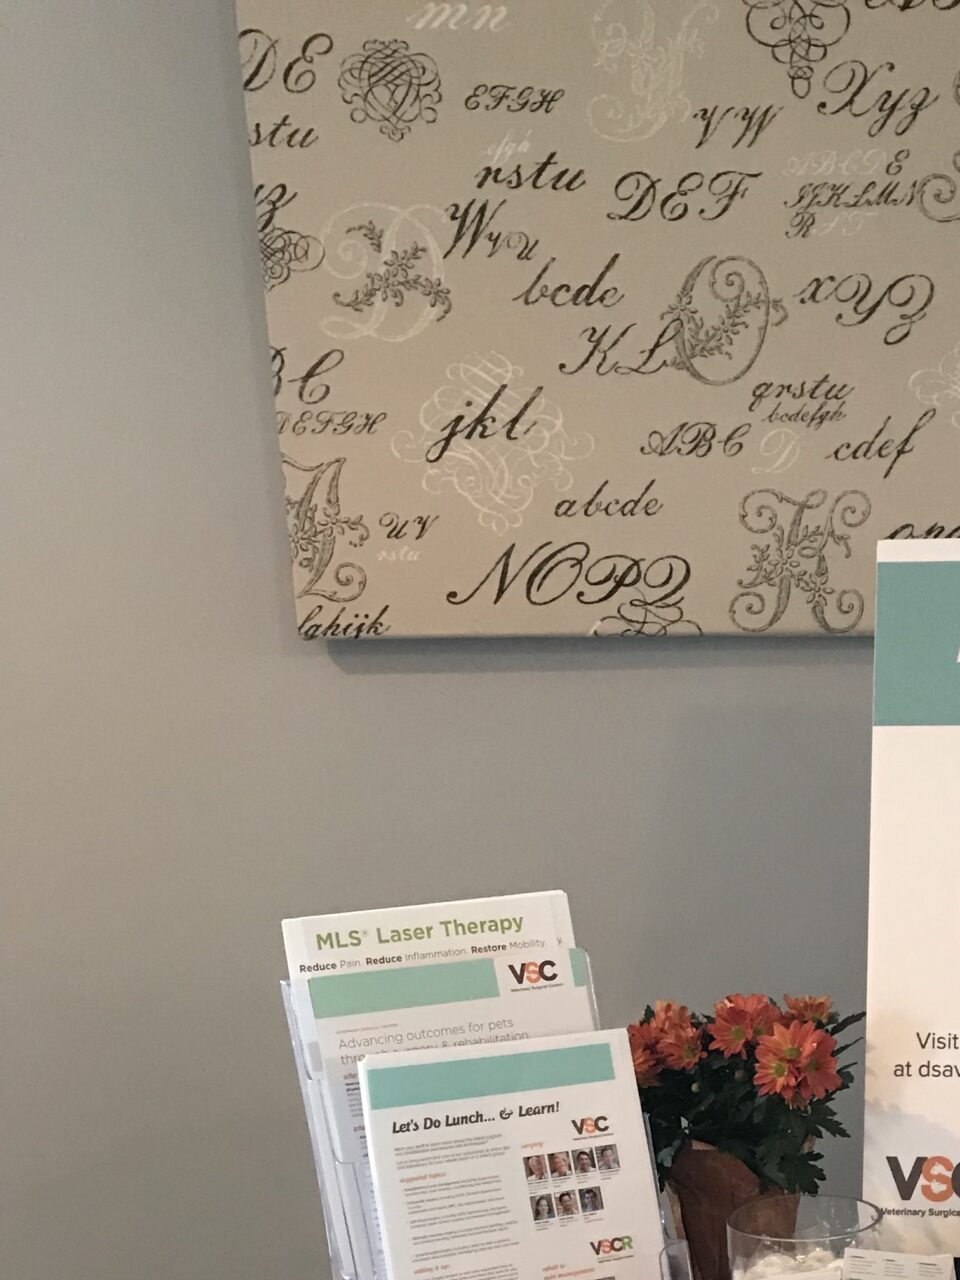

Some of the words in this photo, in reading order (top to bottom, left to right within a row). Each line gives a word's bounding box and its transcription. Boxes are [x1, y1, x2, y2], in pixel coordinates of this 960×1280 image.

[513, 253, 624, 308] bcde
[425, 384, 543, 463] jkl
[553, 478, 663, 518] abcde
[376, 923, 433, 945] Laser
[439, 915, 524, 941] Therapy
[299, 961, 337, 974] Reduce
[365, 954, 403, 966] Reduce
[471, 943, 507, 955] Restore
[508, 960, 558, 984] VSC
[338, 1032, 404, 1051] Advancing
[406, 1025, 466, 1041] outcomes
[468, 1021, 484, 1033] for
[488, 1018, 514, 1031] pets
[916, 1032, 959, 1052] Visit
[894, 1062, 913, 1079] at
[392, 1119, 419, 1134] Let's
[423, 1116, 441, 1129] Do
[445, 1110, 496, 1127] Lunch...
[499, 1107, 513, 1120] &
[518, 1101, 560, 1118] Learn!
[571, 1116, 609, 1135] VSC
[881, 1207, 926, 1218] Veterinary
[589, 1235, 634, 1256] VSCR
